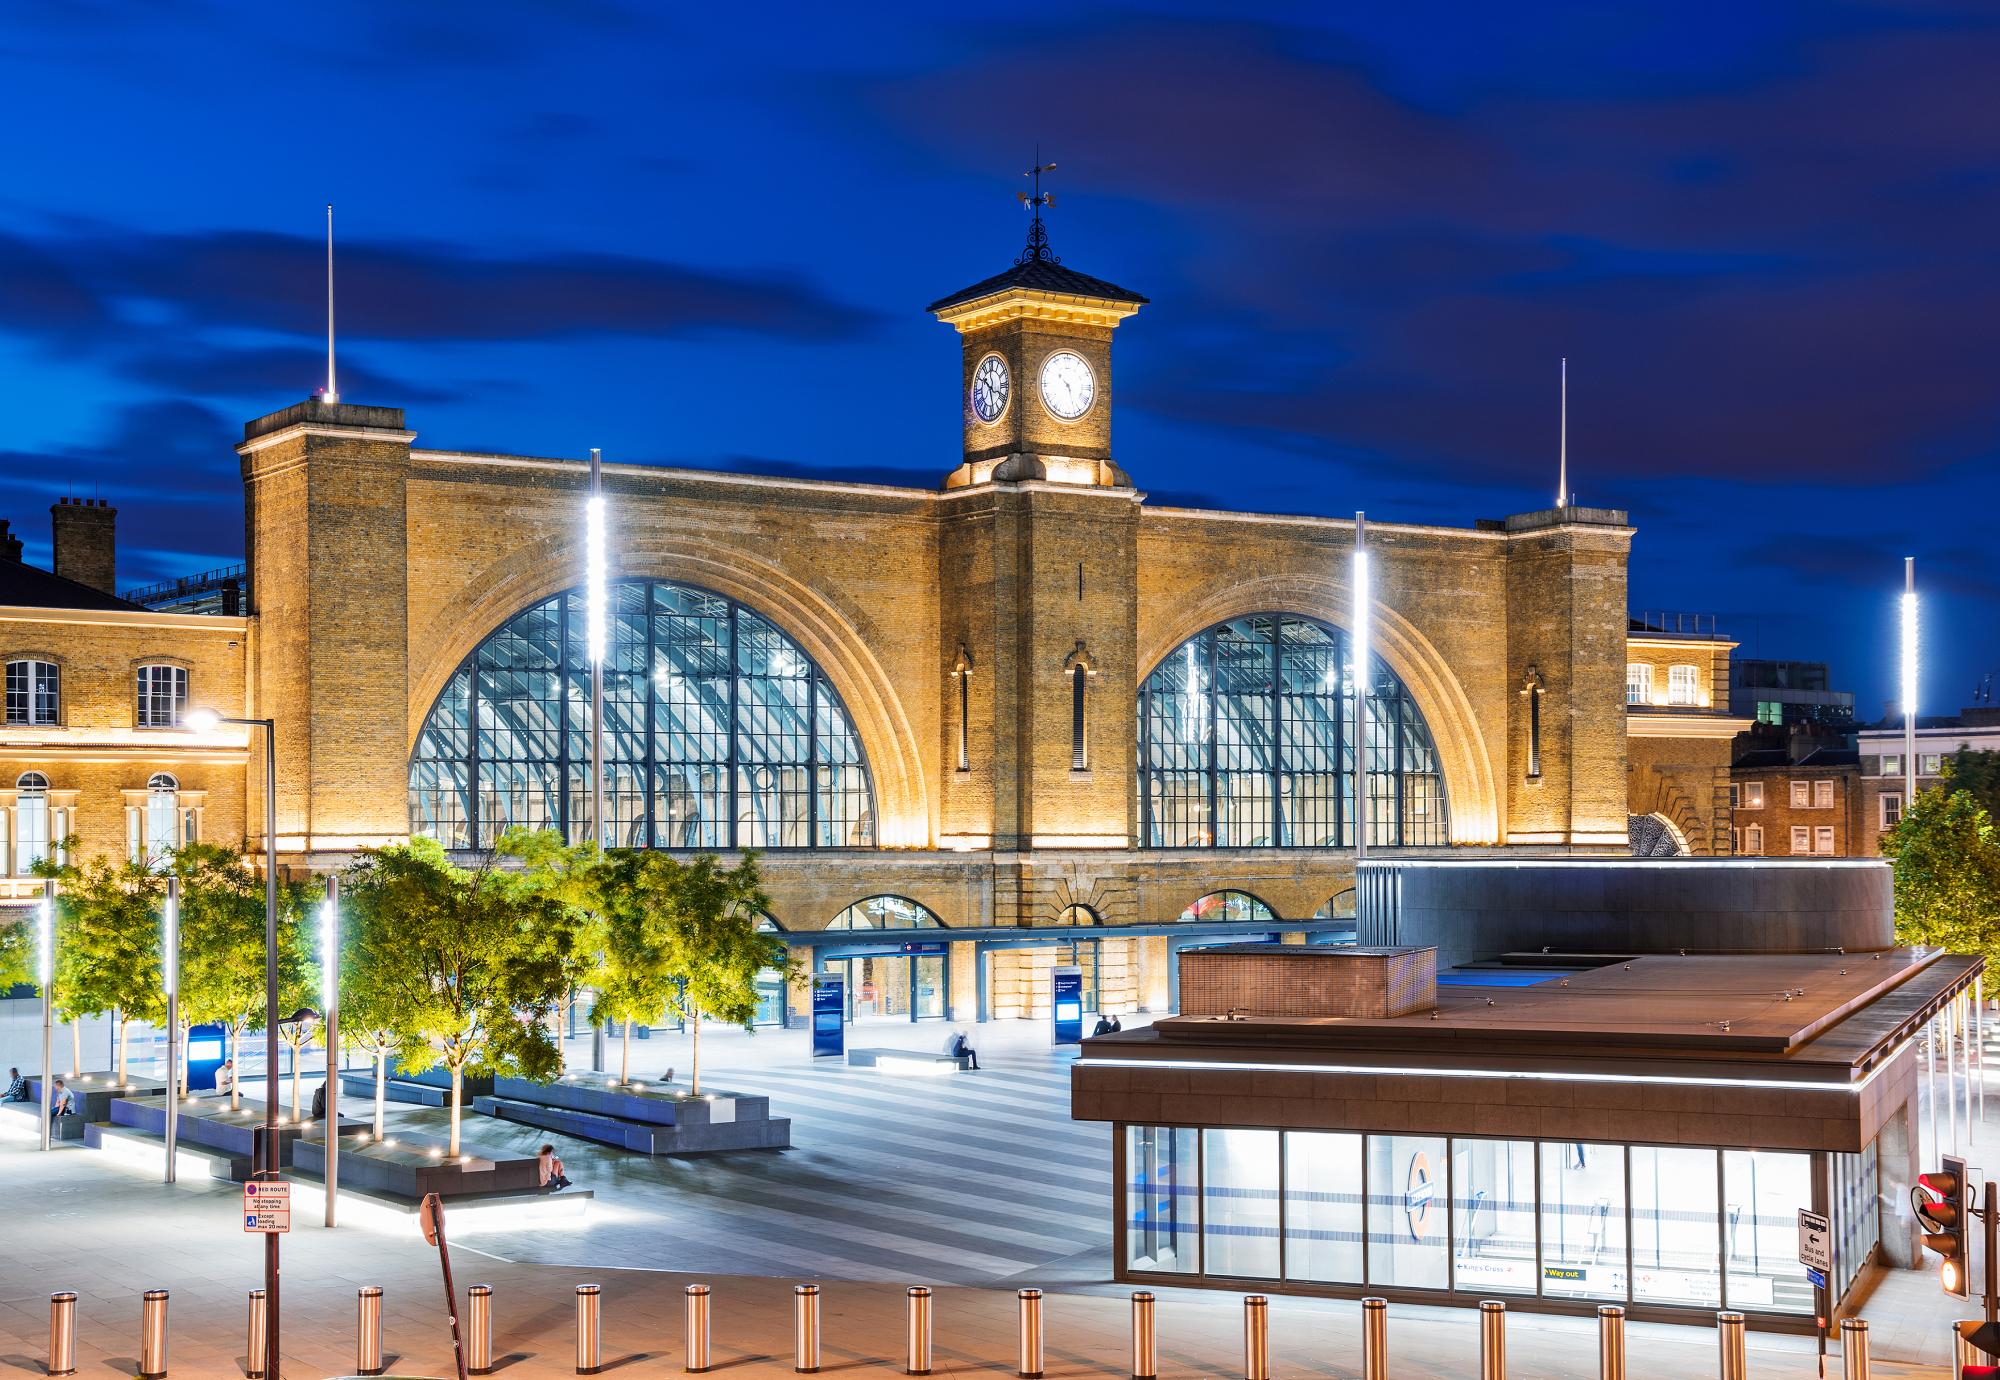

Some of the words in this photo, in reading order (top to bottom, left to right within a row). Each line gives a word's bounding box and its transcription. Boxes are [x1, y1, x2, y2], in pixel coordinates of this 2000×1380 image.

[1804, 1244, 1814, 1254] Bus
[1815, 1249, 1824, 1257] and
[1801, 1253, 1814, 1262] cycle
[1814, 1256, 1828, 1268] lanes
[1548, 1268, 1564, 1278] Way
